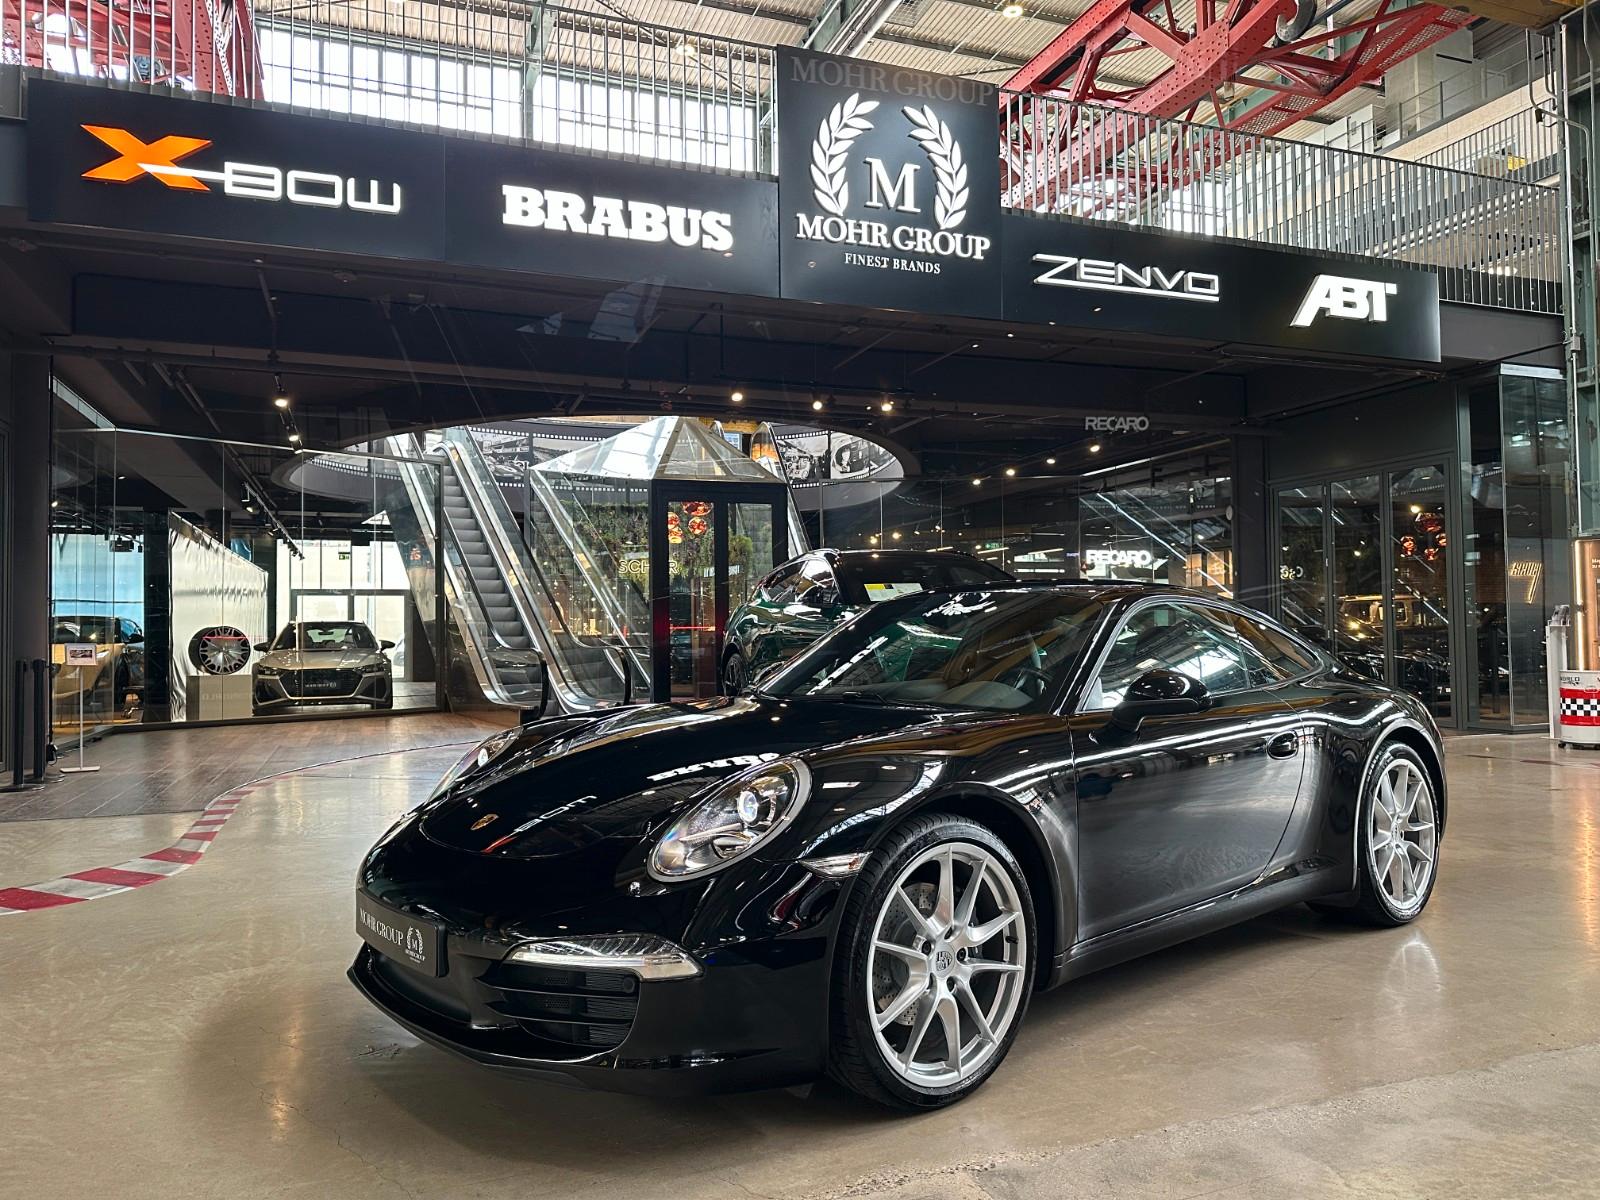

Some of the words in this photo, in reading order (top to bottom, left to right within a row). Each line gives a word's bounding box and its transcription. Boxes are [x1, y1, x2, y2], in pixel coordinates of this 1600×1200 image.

[790, 56, 888, 92] MOHR
[893, 71, 993, 106] GROUP
[864, 157, 921, 213] M
[502, 184, 734, 251] BRABUS
[796, 213, 891, 248] MOHR
[892, 224, 991, 260] GROUP
[845, 253, 889, 268] FINEST
[893, 258, 941, 274] BRANDS
[1032, 253, 1219, 302] ZENVO
[1289, 274, 1398, 328] ABT
[1085, 416, 1149, 431] RECARO
[1086, 550, 1151, 565] RECARO
[376, 920, 404, 945] GROUP
